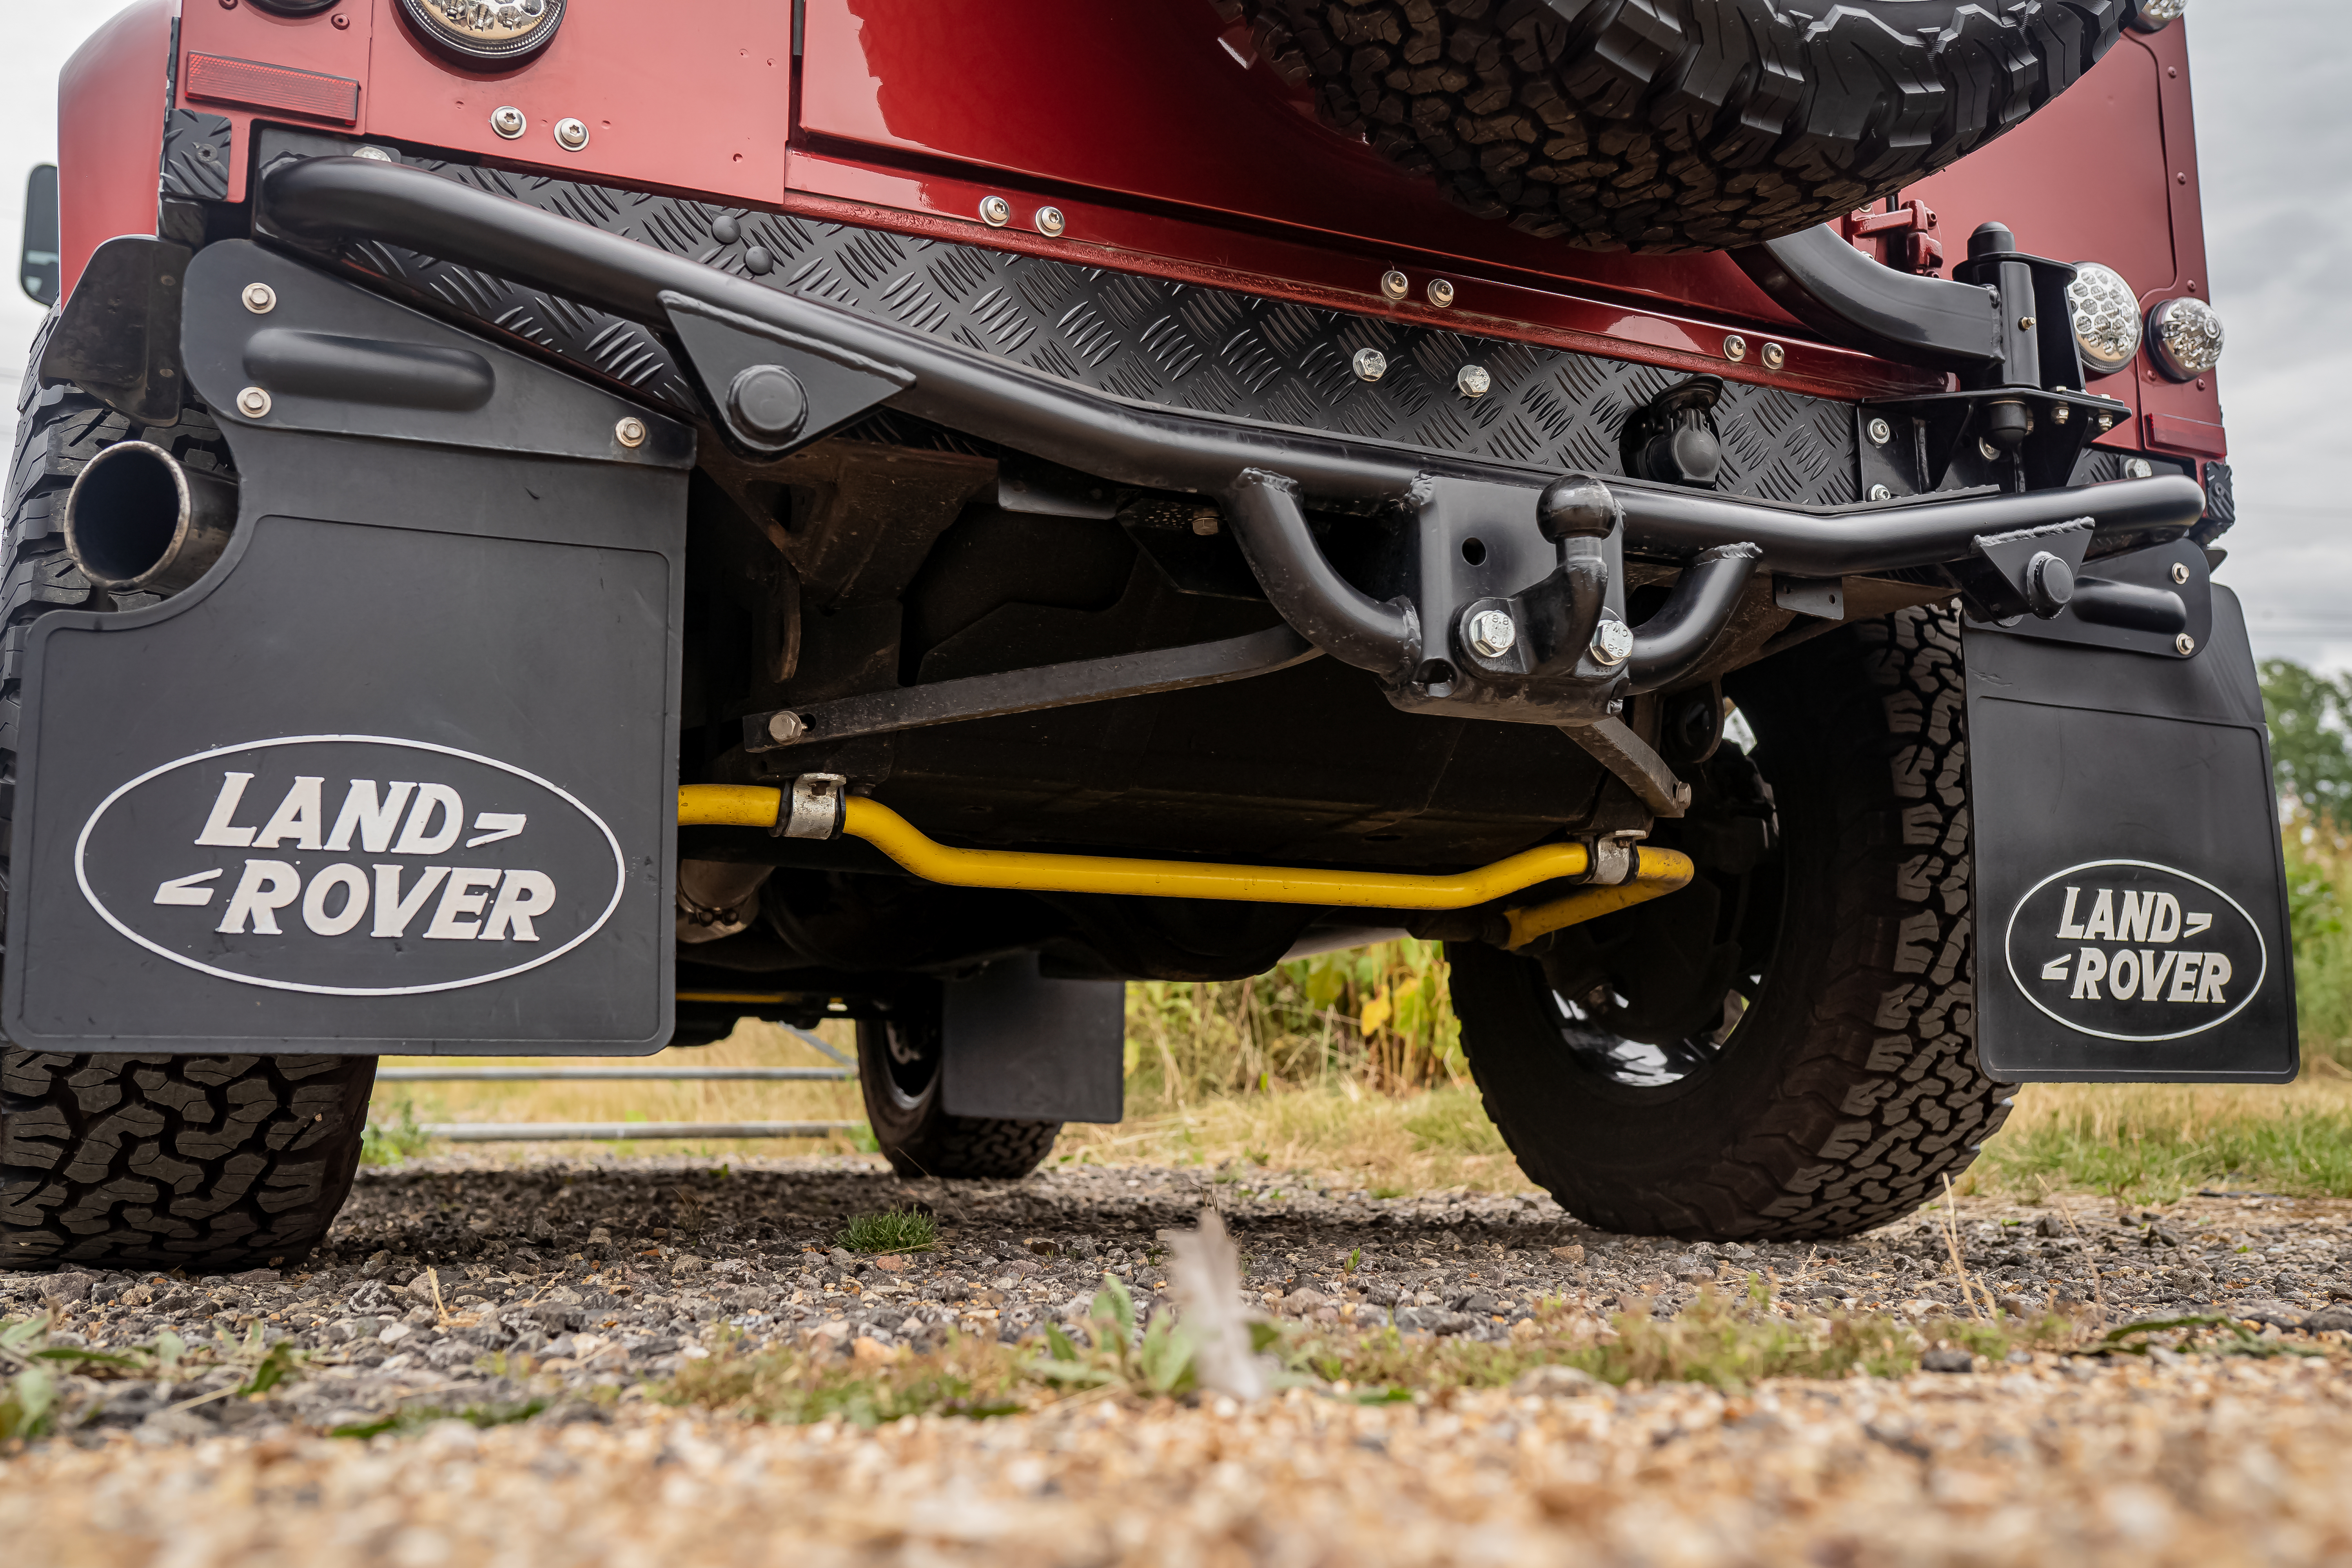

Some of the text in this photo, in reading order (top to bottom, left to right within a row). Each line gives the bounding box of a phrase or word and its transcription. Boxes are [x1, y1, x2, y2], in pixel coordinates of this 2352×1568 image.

[1492, 614, 1509, 625] 8.8
[1608, 643, 1624, 657] 8.8
[194, 772, 464, 855] LAND
[215, 859, 556, 941] ROVER
[2055, 886, 2181, 943] LAND
[2071, 947, 2232, 1003] ROVER
